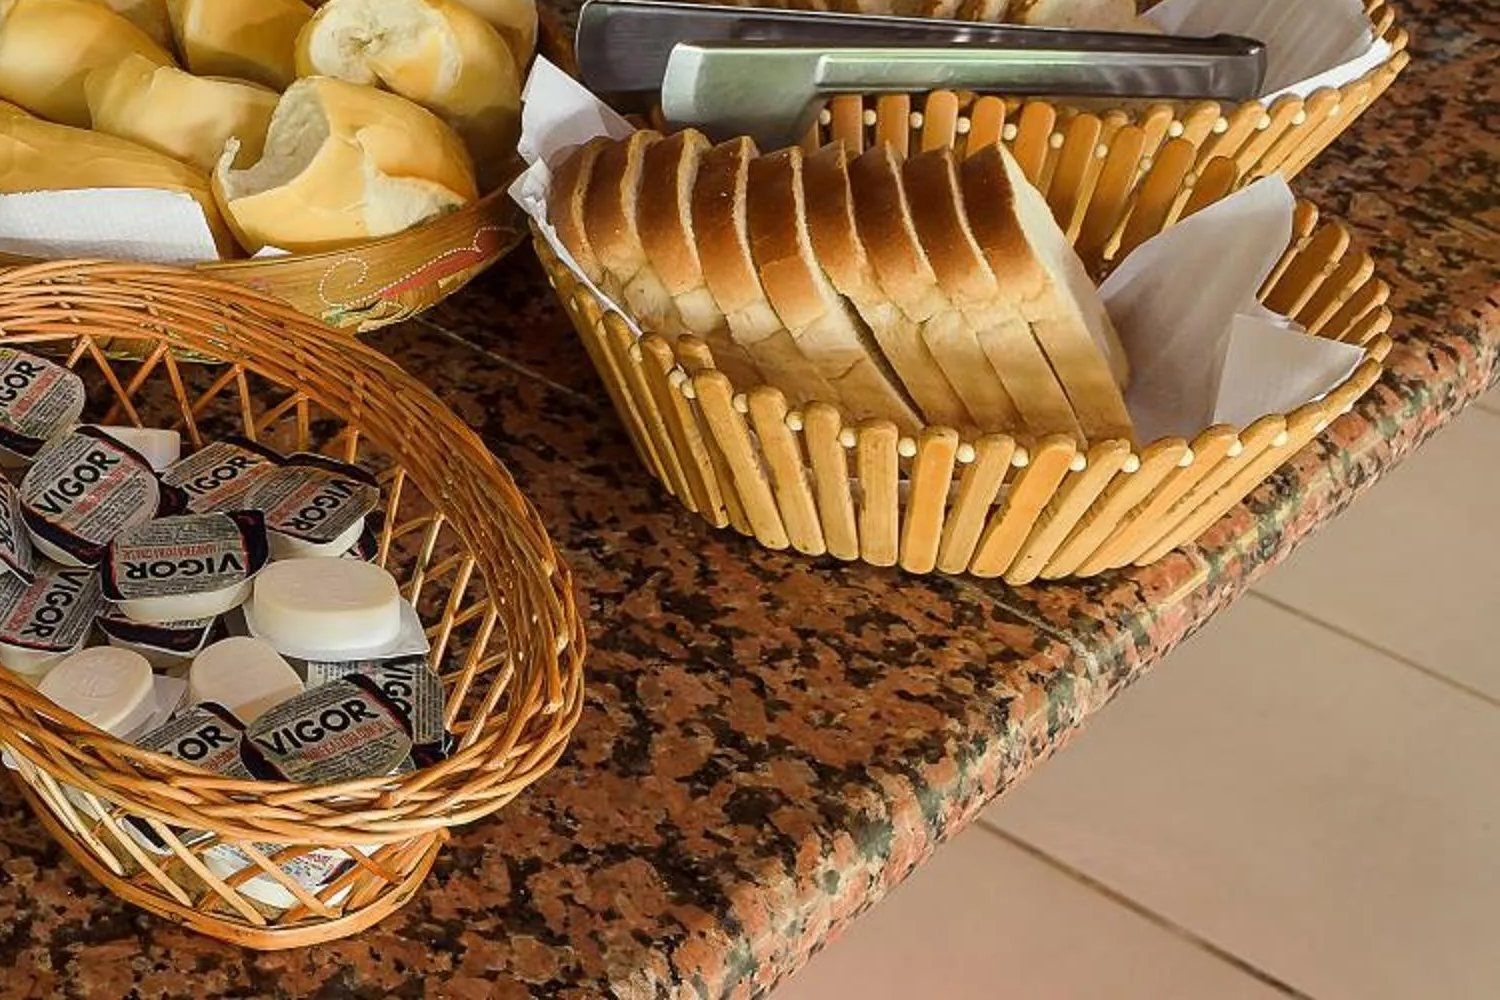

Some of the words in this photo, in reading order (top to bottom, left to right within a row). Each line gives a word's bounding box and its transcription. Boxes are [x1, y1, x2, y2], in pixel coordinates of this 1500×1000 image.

[32, 451, 121, 516] VIGOR
[183, 455, 260, 495] IGOR
[280, 479, 360, 531] VIGOR
[125, 553, 245, 580] VIGOR
[22, 569, 91, 638] VIGOR
[382, 660, 413, 714] VIG
[255, 698, 380, 756] VIGOR
